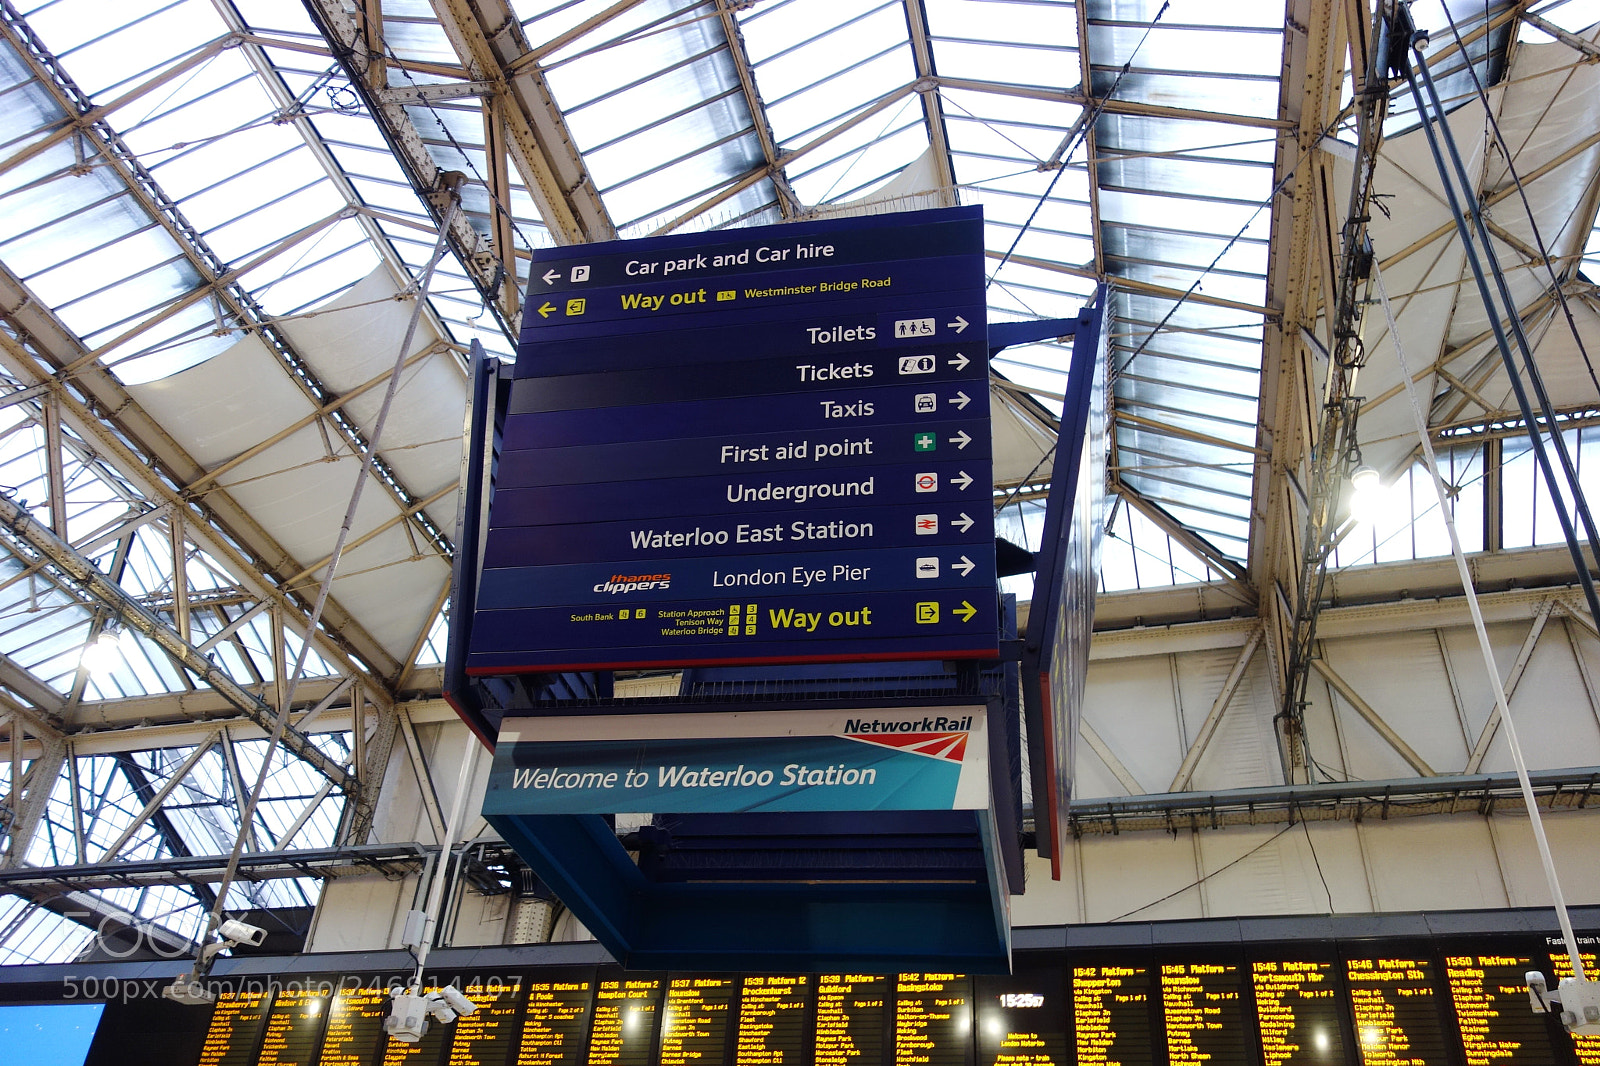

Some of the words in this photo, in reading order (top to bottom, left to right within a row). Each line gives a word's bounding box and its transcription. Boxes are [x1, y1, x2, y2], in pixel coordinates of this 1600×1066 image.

[625, 260, 658, 275] Car
[664, 254, 707, 275] park
[713, 250, 749, 266] and
[756, 245, 791, 262] Car
[796, 244, 834, 259] hire
[621, 295, 664, 311] Way
[670, 289, 706, 305] out
[745, 286, 816, 298] Westminster
[820, 282, 858, 292] Bridge
[862, 278, 891, 288] Road
[807, 326, 876, 344] Toilets
[797, 363, 873, 381] Tickets
[820, 400, 874, 418] Taxis
[721, 444, 769, 463] First
[776, 441, 807, 459] aid
[815, 438, 872, 461] point
[727, 477, 874, 502] Underground
[630, 527, 728, 549] Waterloo
[737, 524, 784, 543] East
[791, 520, 873, 540] Station
[611, 574, 671, 583] thames
[714, 568, 786, 587] London
[793, 567, 826, 585] Eye
[833, 566, 870, 581] Pier
[593, 581, 670, 594] clippers
[687, 609, 724, 617] Approach
[769, 609, 824, 632] Way
[828, 607, 871, 626] out
[512, 768, 617, 789] Welcome
[625, 769, 649, 788] to
[658, 765, 773, 787] Waterloo
[780, 763, 876, 786] Station
[1283, 962, 1317, 971] Platform
[1379, 960, 1415, 969] Platform
[1478, 957, 1516, 966] Platform
[1102, 967, 1134, 976] Platform
[1191, 965, 1224, 973] Platform
[1447, 969, 1484, 978] Reading
[1162, 977, 1200, 985] Hounslow
[1253, 974, 1305, 982] Portsmouth
[1348, 972, 1404, 981] Chessington
[1407, 971, 1424, 980] Sth
[898, 984, 943, 992] Basingstoke
[1073, 979, 1121, 987] Shepperton
